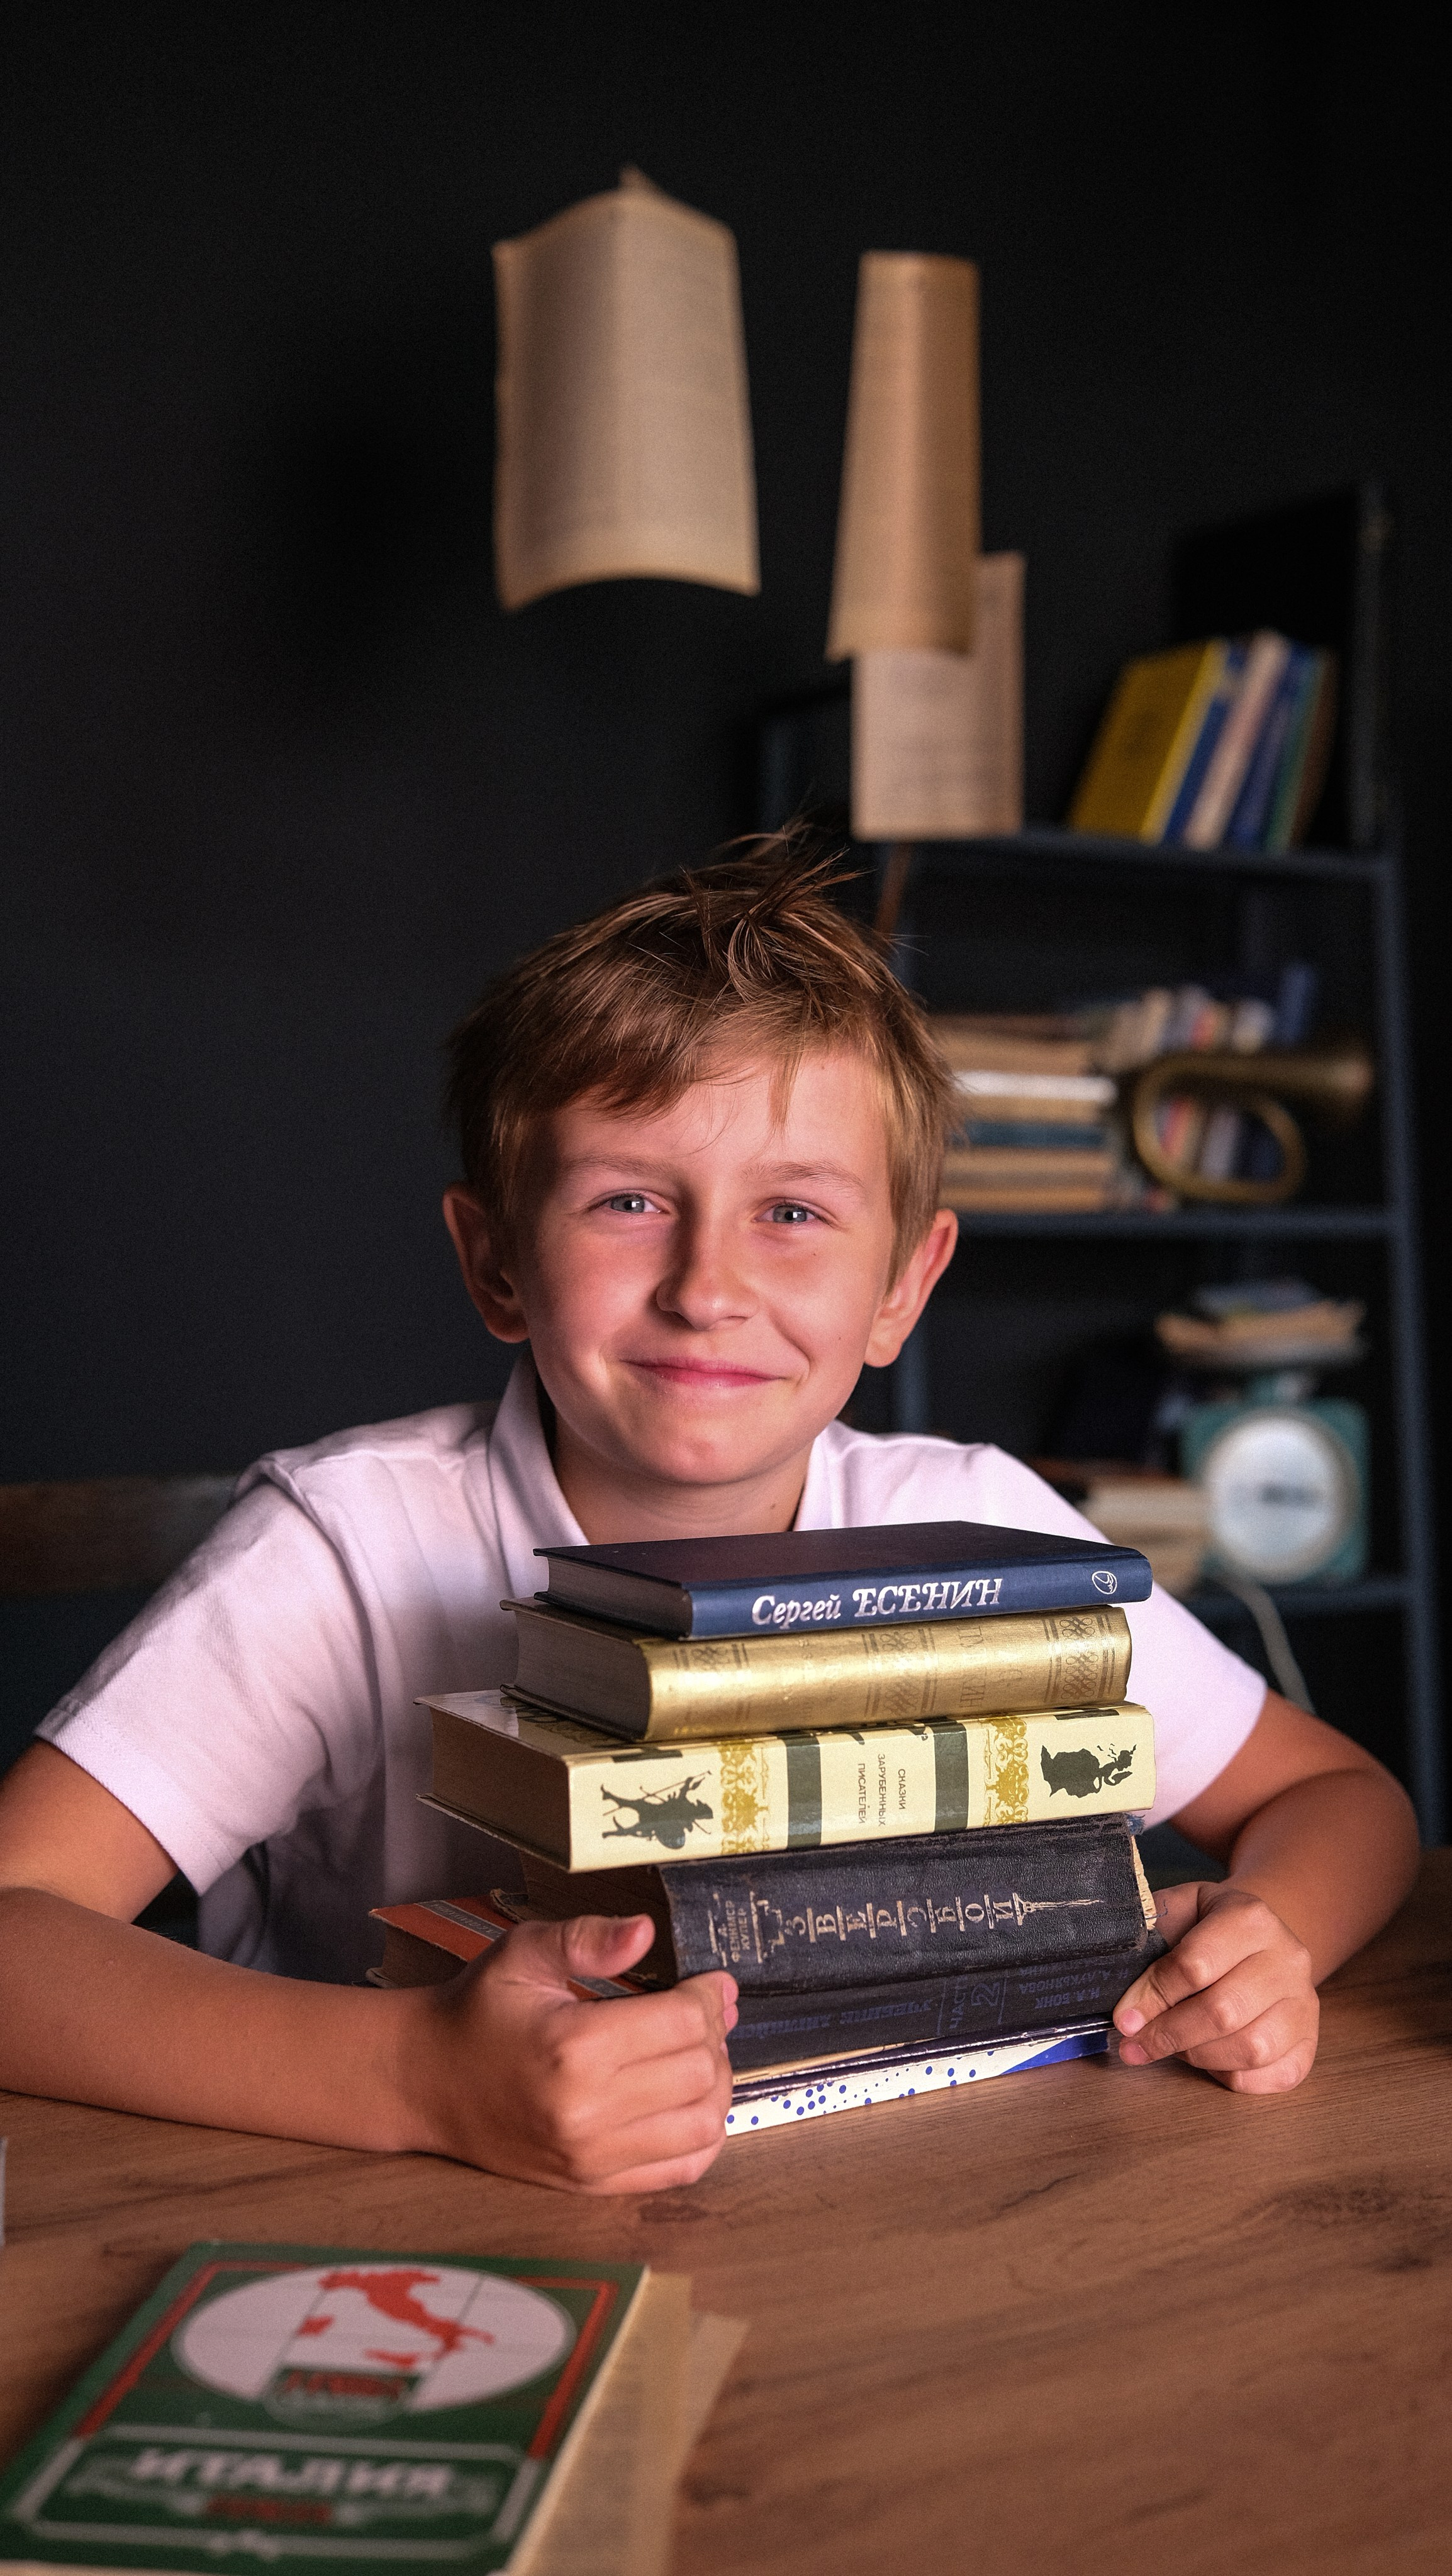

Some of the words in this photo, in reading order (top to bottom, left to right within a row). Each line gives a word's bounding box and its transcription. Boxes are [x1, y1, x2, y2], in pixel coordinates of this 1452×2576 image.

[752, 1594, 842, 1629] Сергей
[852, 1578, 1003, 1618] ЕСЕНИН
[857, 1762, 867, 1824] ПИСАТЕЛЕЙ
[877, 1753, 886, 1827] ЗАРУБЕЖНЫХ
[898, 1768, 907, 1810] СКАЗКИ
[970, 1981, 1000, 2007] 2
[1019, 1971, 1097, 1994] ЛУКЬЯНОВА
[1035, 1992, 1070, 2009] БОНК
